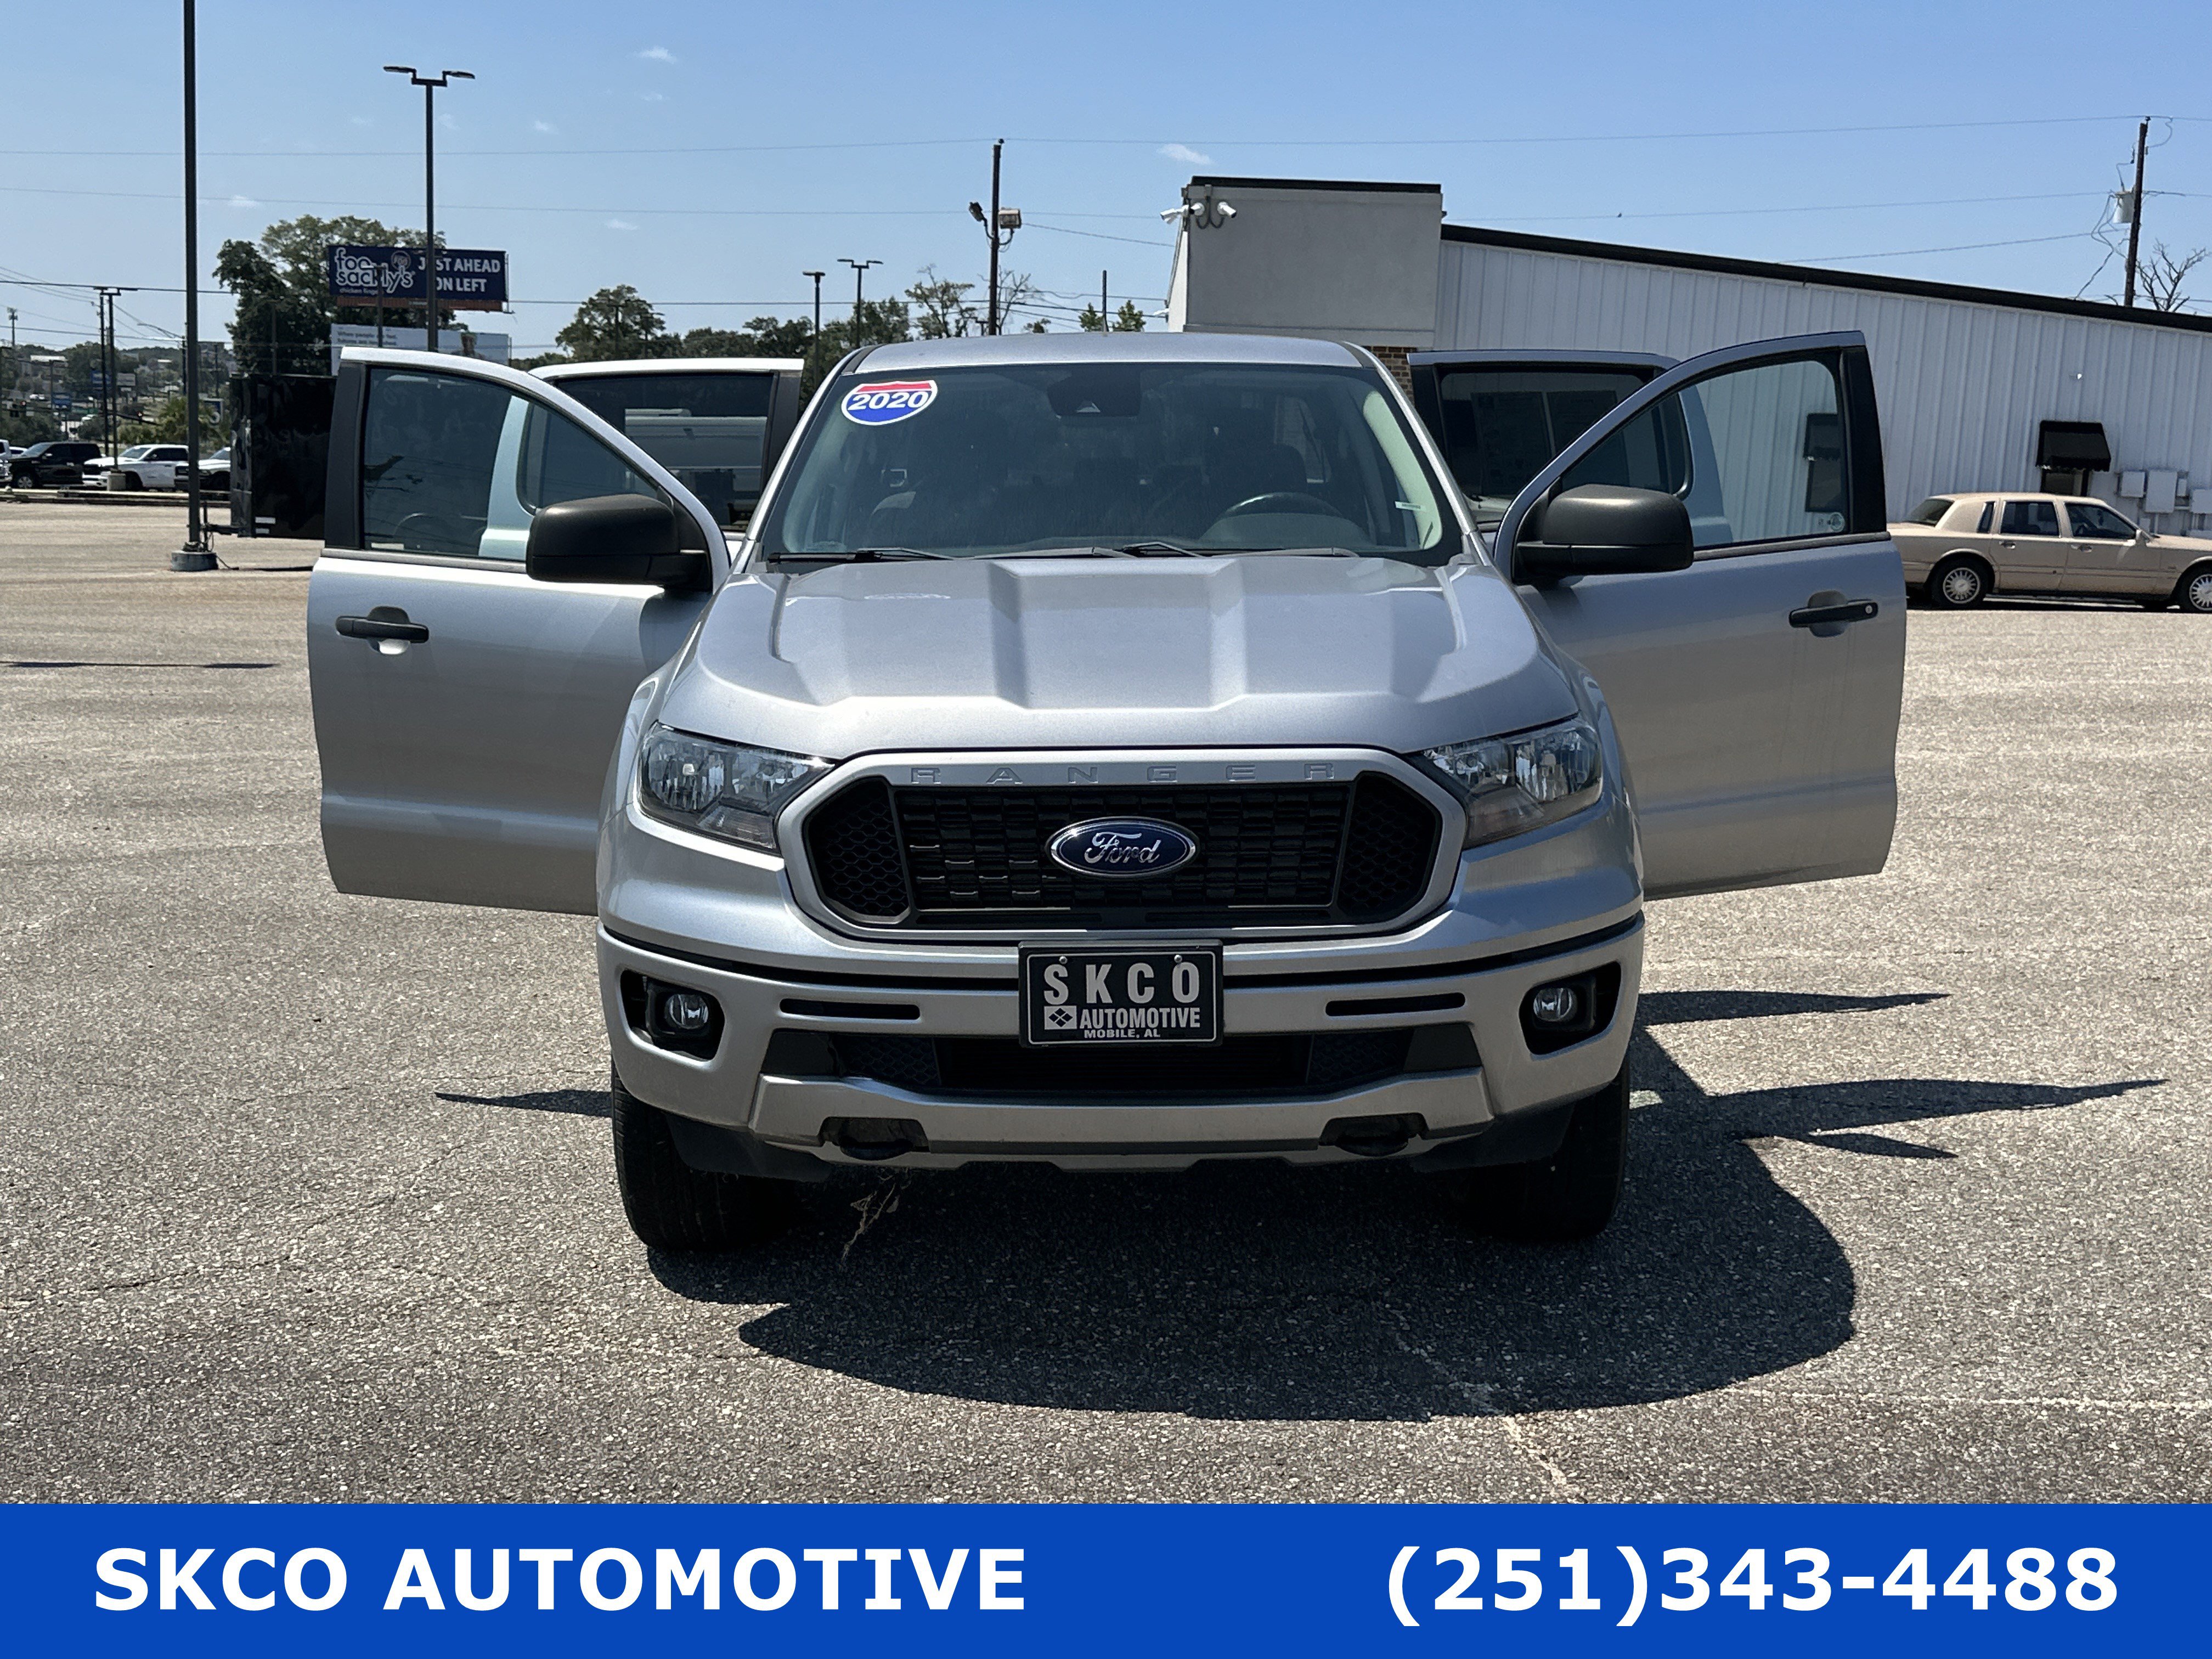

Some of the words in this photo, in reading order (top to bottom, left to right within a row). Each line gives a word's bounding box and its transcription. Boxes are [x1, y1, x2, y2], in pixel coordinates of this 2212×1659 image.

[418, 257, 452, 271] JST
[454, 258, 501, 273] AHEAD
[456, 278, 487, 292] LEFT
[848, 391, 929, 410] 2020
[911, 763, 1335, 785] RANGER
[1084, 832, 1161, 864] Ford
[1079, 1007, 1200, 1029] AUTOMOTIVE
[1084, 1029, 1140, 1039] MOBILE,
[1144, 1029, 1161, 1038] AL
